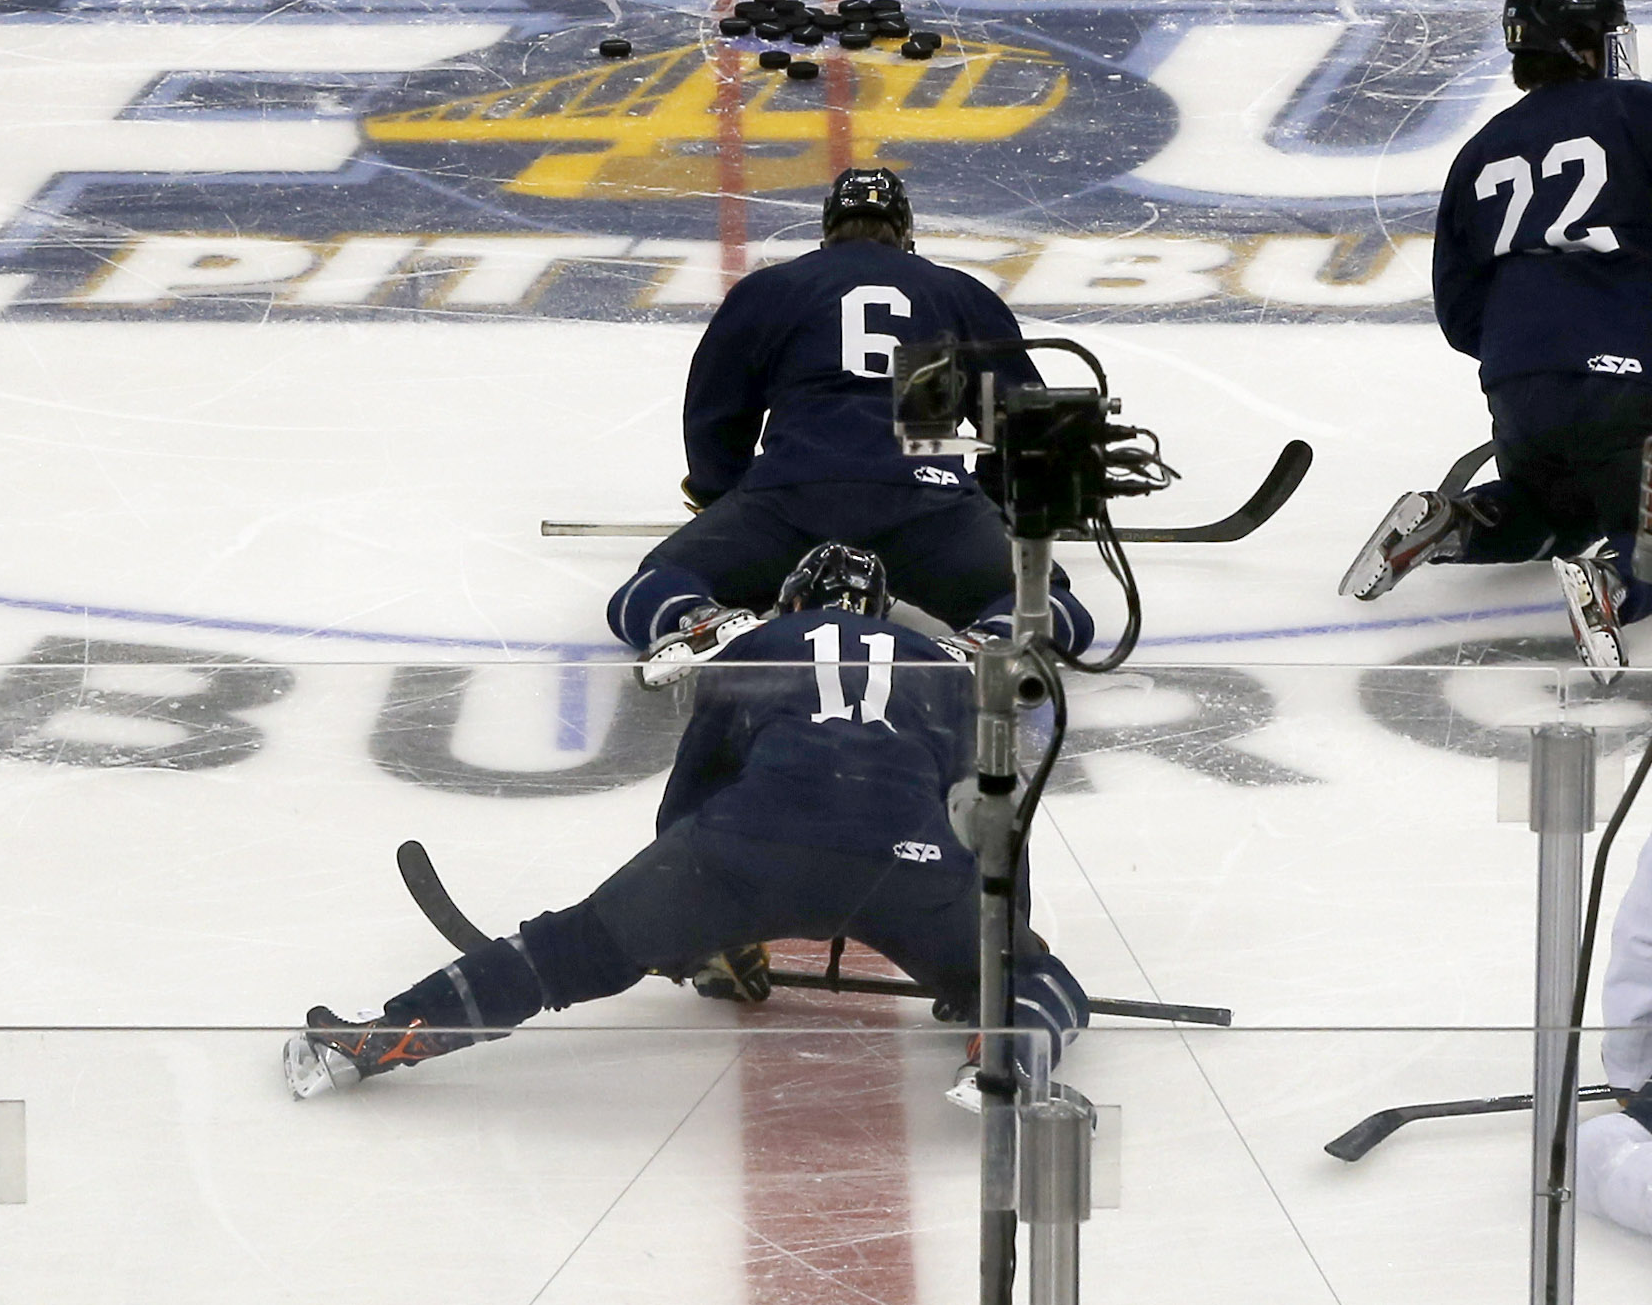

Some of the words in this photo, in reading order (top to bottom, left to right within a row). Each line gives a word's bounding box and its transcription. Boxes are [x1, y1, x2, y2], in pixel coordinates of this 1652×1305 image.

[1475, 136, 1620, 258] 72
[841, 285, 911, 379] 6
[803, 622, 897, 733] 11
